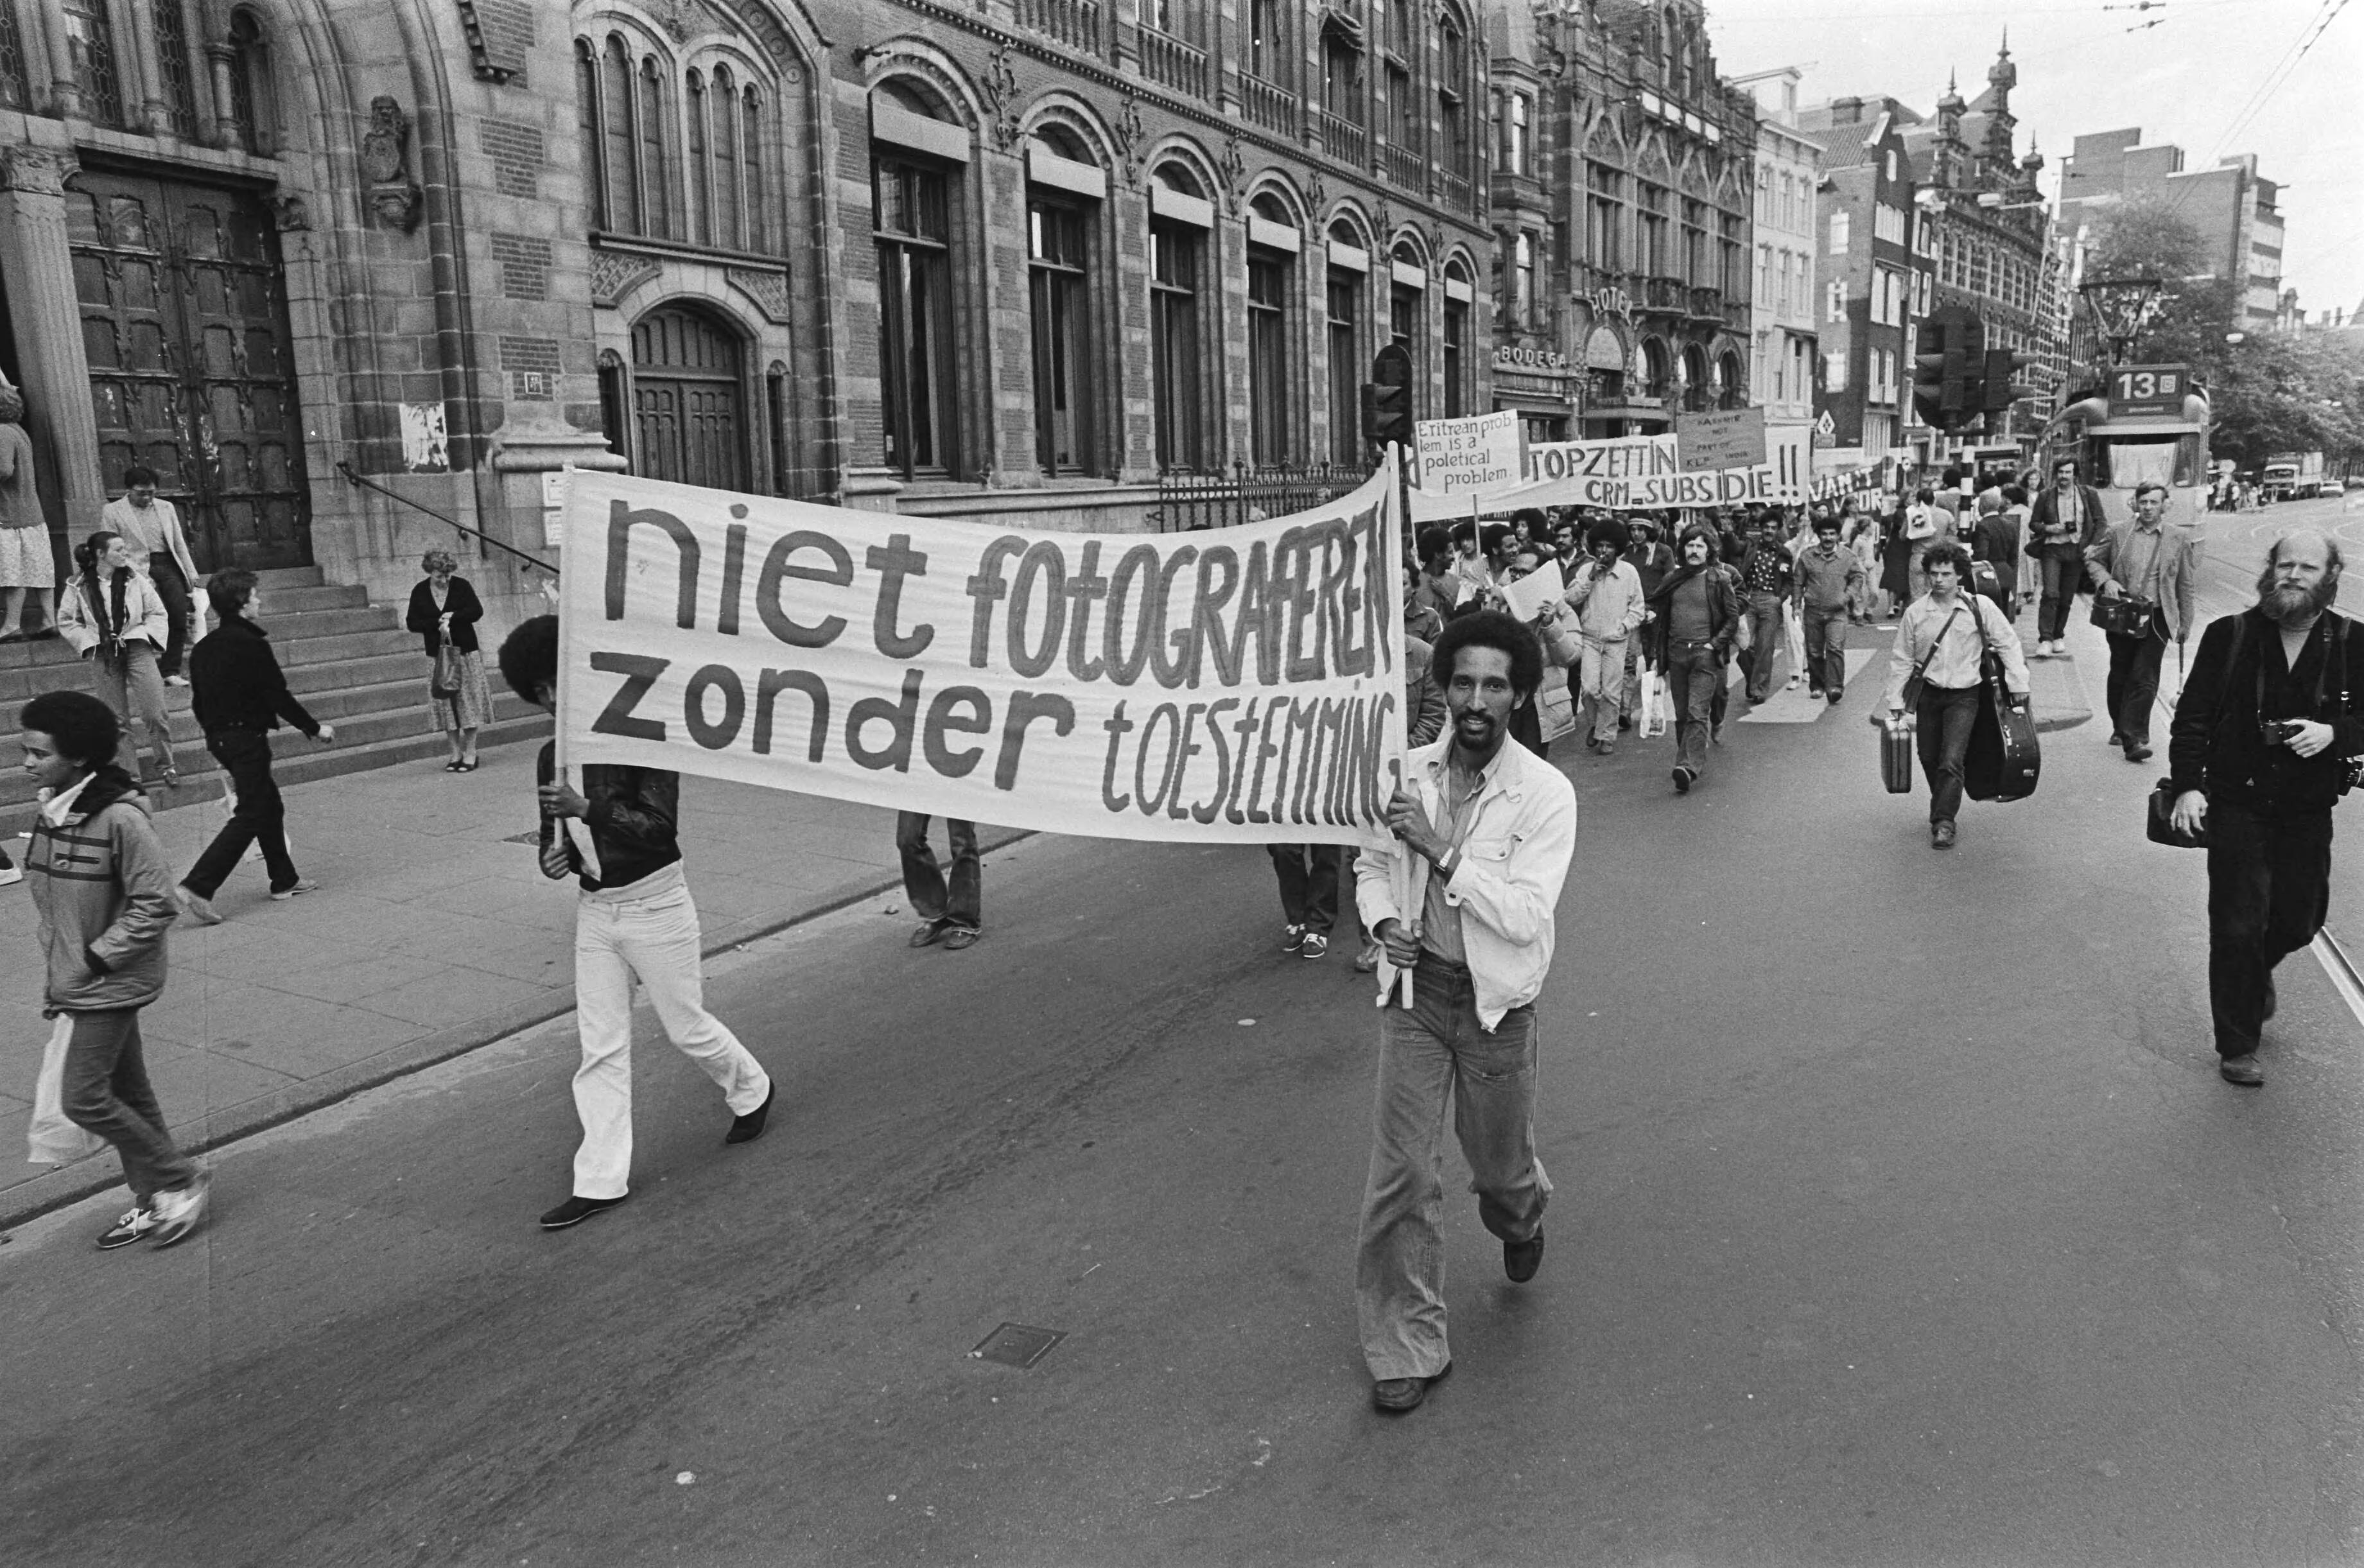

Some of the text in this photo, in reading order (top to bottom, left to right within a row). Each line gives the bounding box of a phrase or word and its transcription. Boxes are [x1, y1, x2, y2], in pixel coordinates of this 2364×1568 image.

[1589, 286, 1633, 326] HOTEL
[1502, 345, 1567, 367] BODEGA
[2118, 372, 2155, 399] 13
[1418, 413, 1511, 438] Eritrean prob
[1420, 439, 1442, 453] lem
[1468, 437, 1477, 449] a
[1426, 448, 1490, 476] poletical
[605, 499, 935, 659] niet
[589, 651, 1077, 790] zonder
